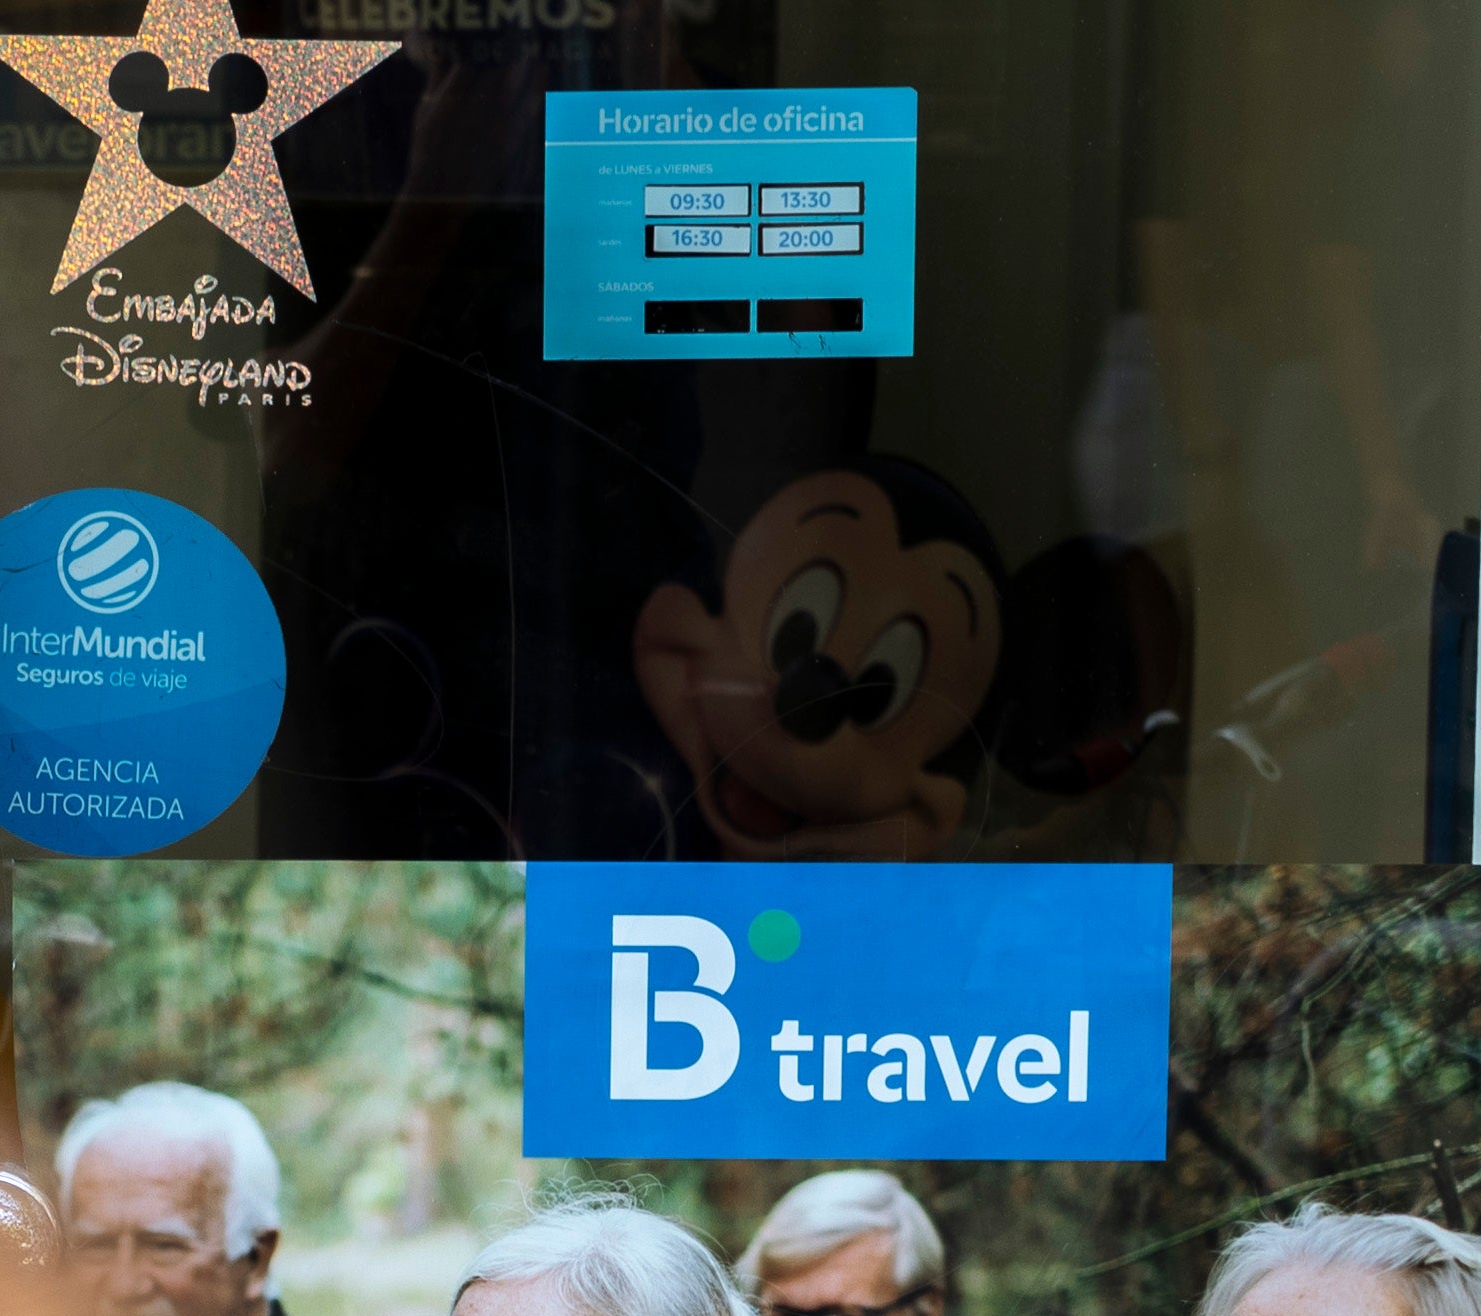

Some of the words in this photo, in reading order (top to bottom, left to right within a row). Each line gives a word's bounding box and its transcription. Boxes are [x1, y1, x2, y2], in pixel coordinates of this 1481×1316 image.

[599, 107, 713, 134] Horario
[720, 107, 757, 133] de
[764, 105, 864, 132] oficina
[599, 165, 612, 175] de
[615, 165, 652, 175] LUNES
[663, 164, 713, 174] VIERNES
[670, 194, 724, 210] 09:30
[781, 192, 831, 208] 13:30
[672, 230, 722, 247] 16:30
[779, 231, 833, 248] 20:00
[219, 393, 311, 406] PARIS
[4, 624, 205, 661] InterMundial
[17, 663, 103, 687] Seguros
[110, 668, 135, 686] de
[140, 668, 189, 694] viaje
[36, 758, 158, 783] AGENCIA
[8, 792, 183, 820] AUTORIZADA
[610, 915, 740, 1100] B
[771, 1011, 1089, 1103] travel
